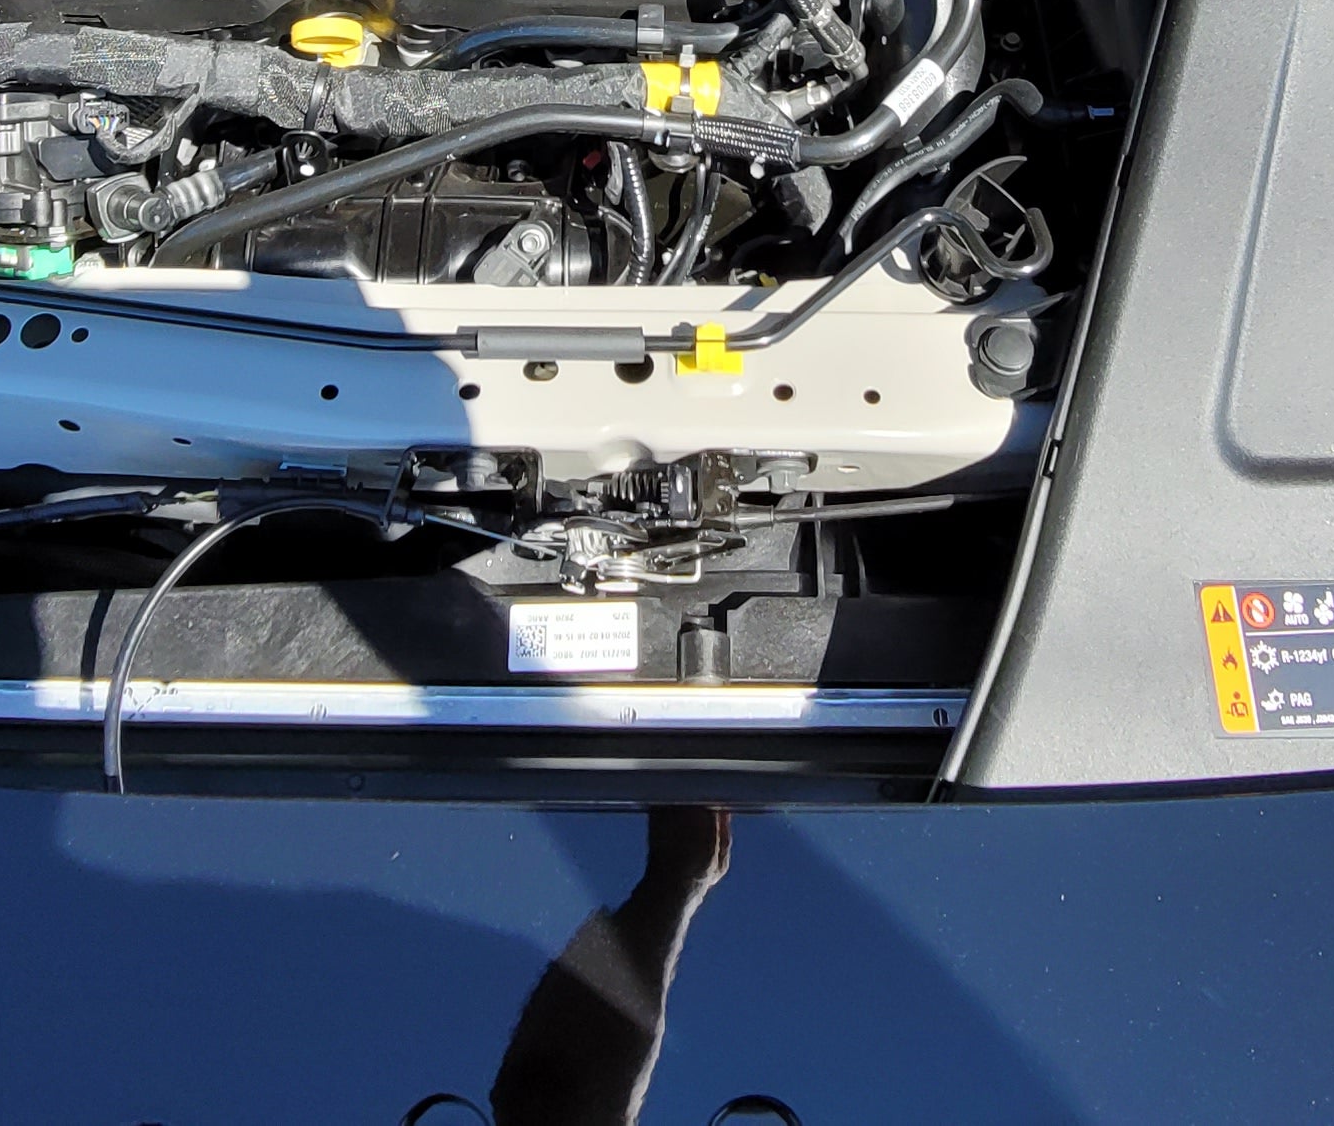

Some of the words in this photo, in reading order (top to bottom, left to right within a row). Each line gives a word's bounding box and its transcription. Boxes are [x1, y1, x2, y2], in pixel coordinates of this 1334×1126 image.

[1284, 613, 1310, 626] AUTO
[1281, 648, 1327, 665] R-1234yf
[1289, 692, 1314, 707] PAG
